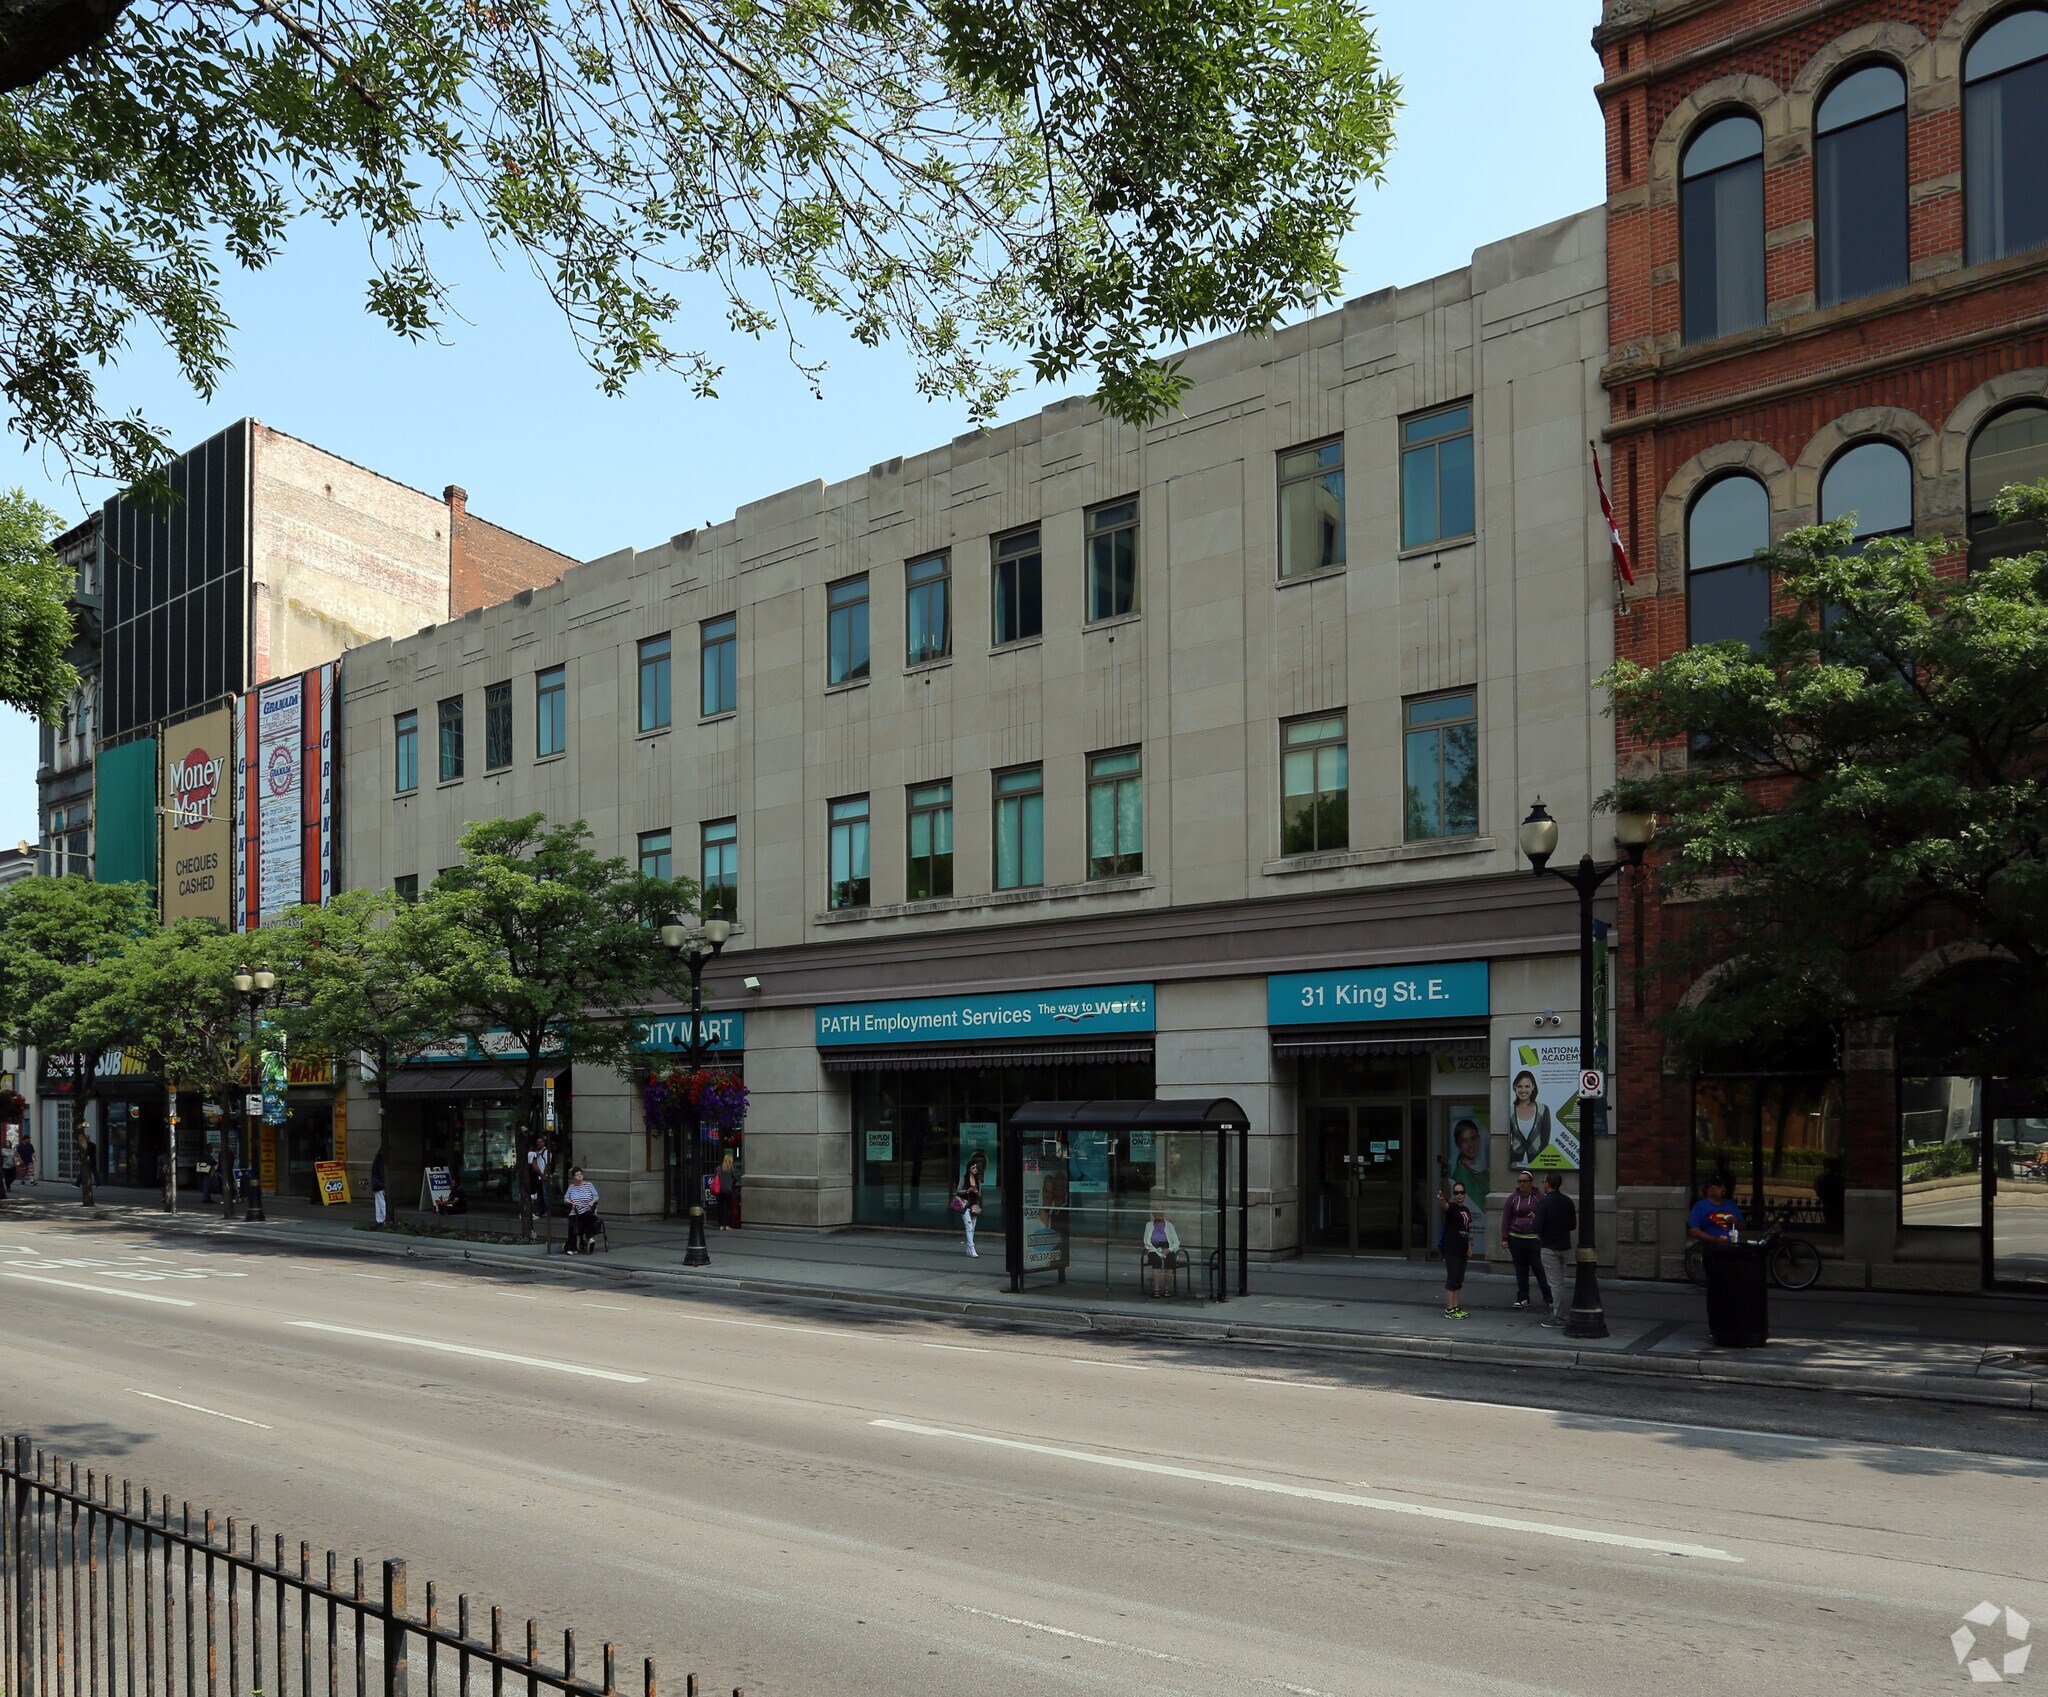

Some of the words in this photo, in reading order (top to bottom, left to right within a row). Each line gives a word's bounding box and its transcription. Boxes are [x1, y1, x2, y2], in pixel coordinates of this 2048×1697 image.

[264, 694, 298, 714] GRANADA
[169, 756, 225, 796] Money
[270, 766, 291, 778] GRANADA
[173, 793, 214, 831] Mart
[322, 731, 330, 909] GRANADA
[176, 853, 218, 876] CHEQUES
[179, 875, 214, 896] CASHED
[1301, 986, 1324, 1007] 31
[1336, 984, 1387, 1008] King
[1393, 979, 1422, 1002] St.
[1428, 979, 1449, 1000] E.
[1038, 1003, 1056, 1014] The
[1058, 1004, 1079, 1015] way
[1081, 1002, 1093, 1012] to
[821, 1016, 860, 1033] PATH
[865, 1011, 958, 1033] Employment
[962, 1007, 1032, 1026] Services
[681, 1019, 733, 1043] MART
[504, 1035, 523, 1050] GRILL
[94, 1046, 148, 1077] SUBWA
[1457, 1055, 1489, 1063] NATION
[291, 1061, 326, 1083] MART
[330, 1193, 342, 1201] ATM
[3, 1256, 178, 1269] ONLY
[94, 1268, 249, 1281] BUS
